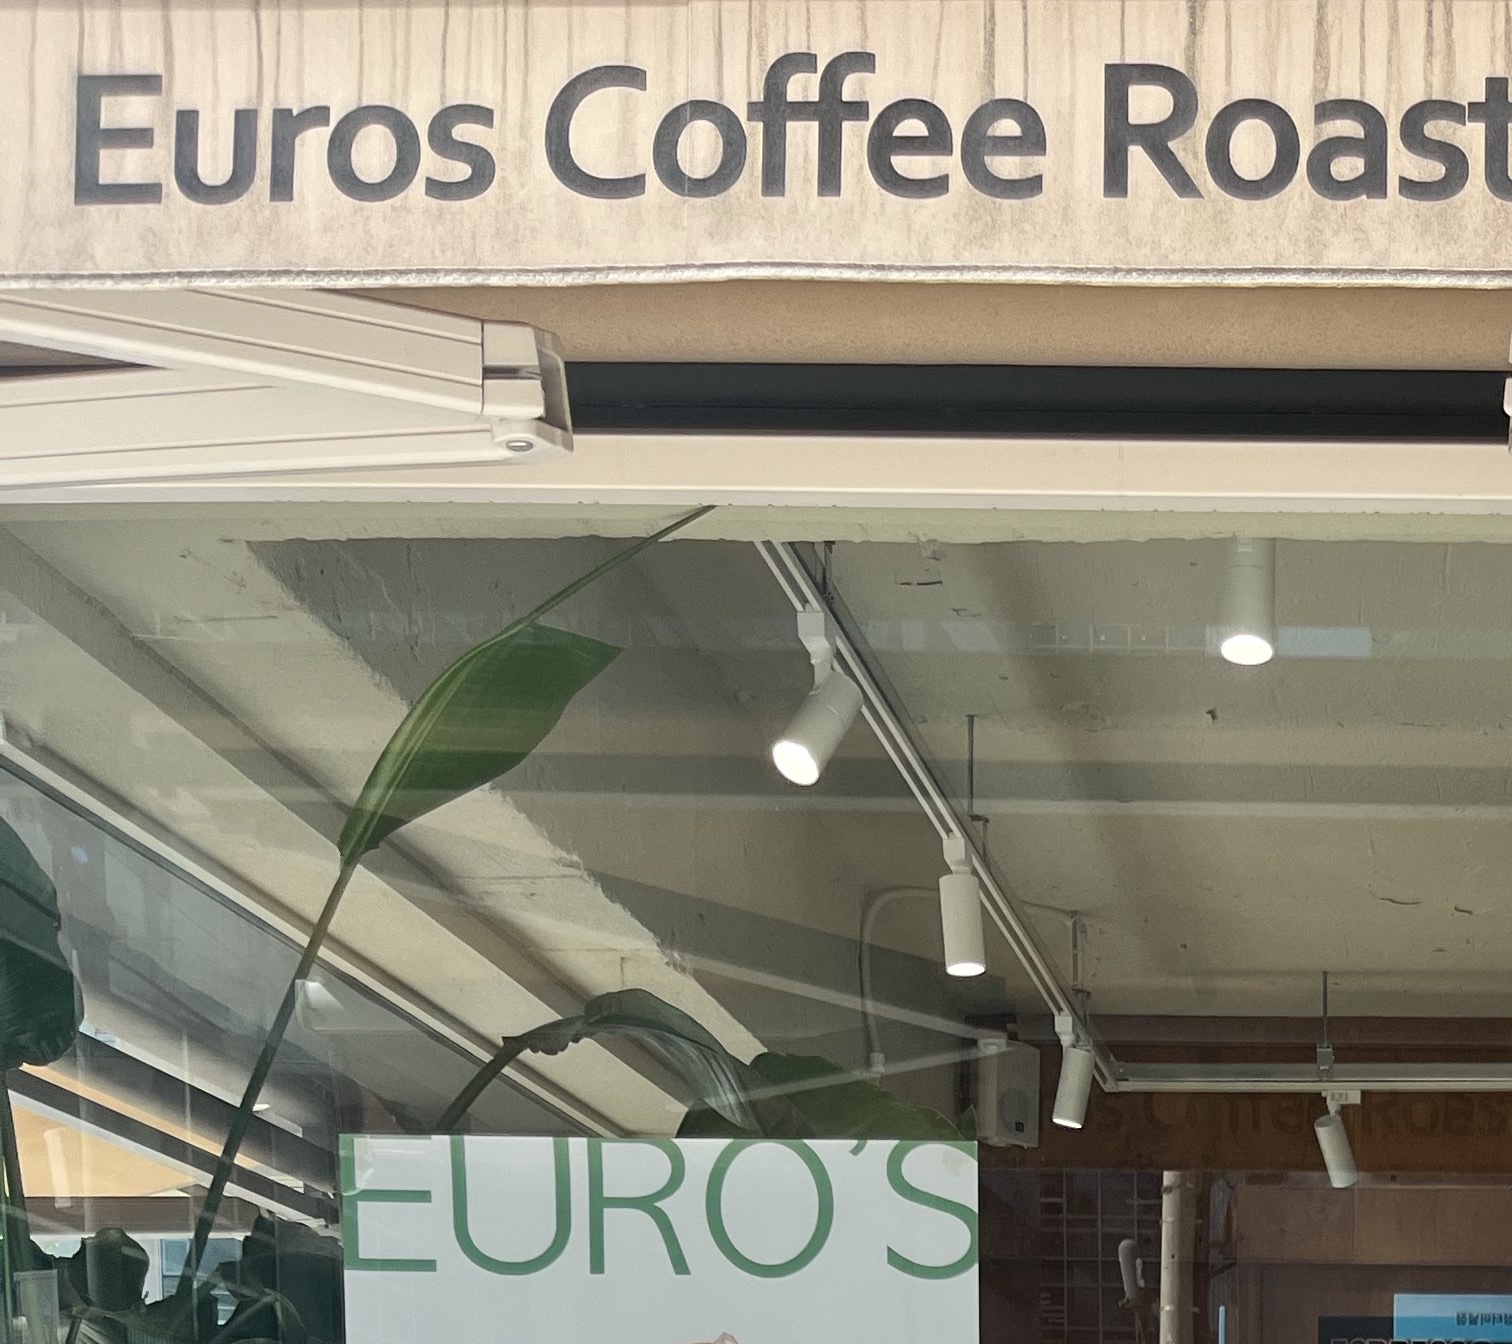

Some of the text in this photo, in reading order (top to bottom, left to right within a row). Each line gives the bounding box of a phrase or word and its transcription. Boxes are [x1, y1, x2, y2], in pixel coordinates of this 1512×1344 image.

[72, 70, 496, 206] Euros
[543, 49, 1048, 202] Coffee
[340, 1135, 978, 1280] EURO'S
